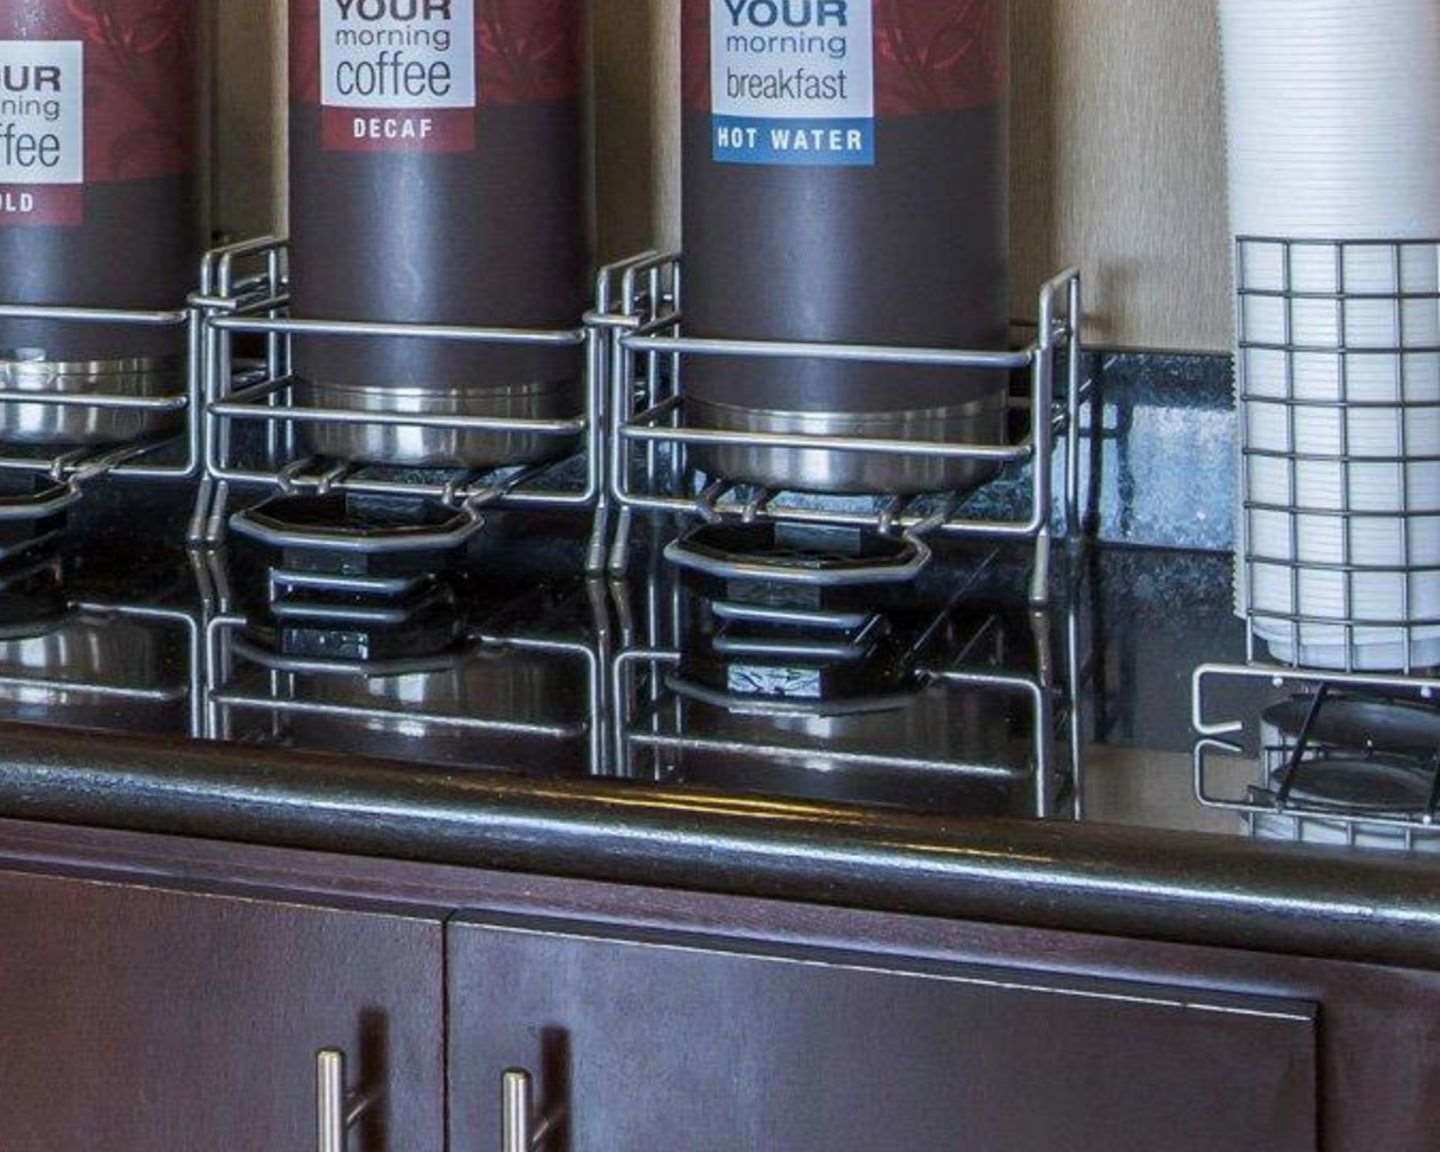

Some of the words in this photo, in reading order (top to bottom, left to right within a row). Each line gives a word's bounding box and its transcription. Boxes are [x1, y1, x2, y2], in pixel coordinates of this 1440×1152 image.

[335, 25, 451, 52] morning
[726, 32, 847, 59] morning
[336, 50, 452, 96] coffee
[726, 67, 847, 99] breakfast
[353, 117, 433, 139] DECAF
[717, 127, 758, 148] HOT
[770, 129, 862, 151] WATER
